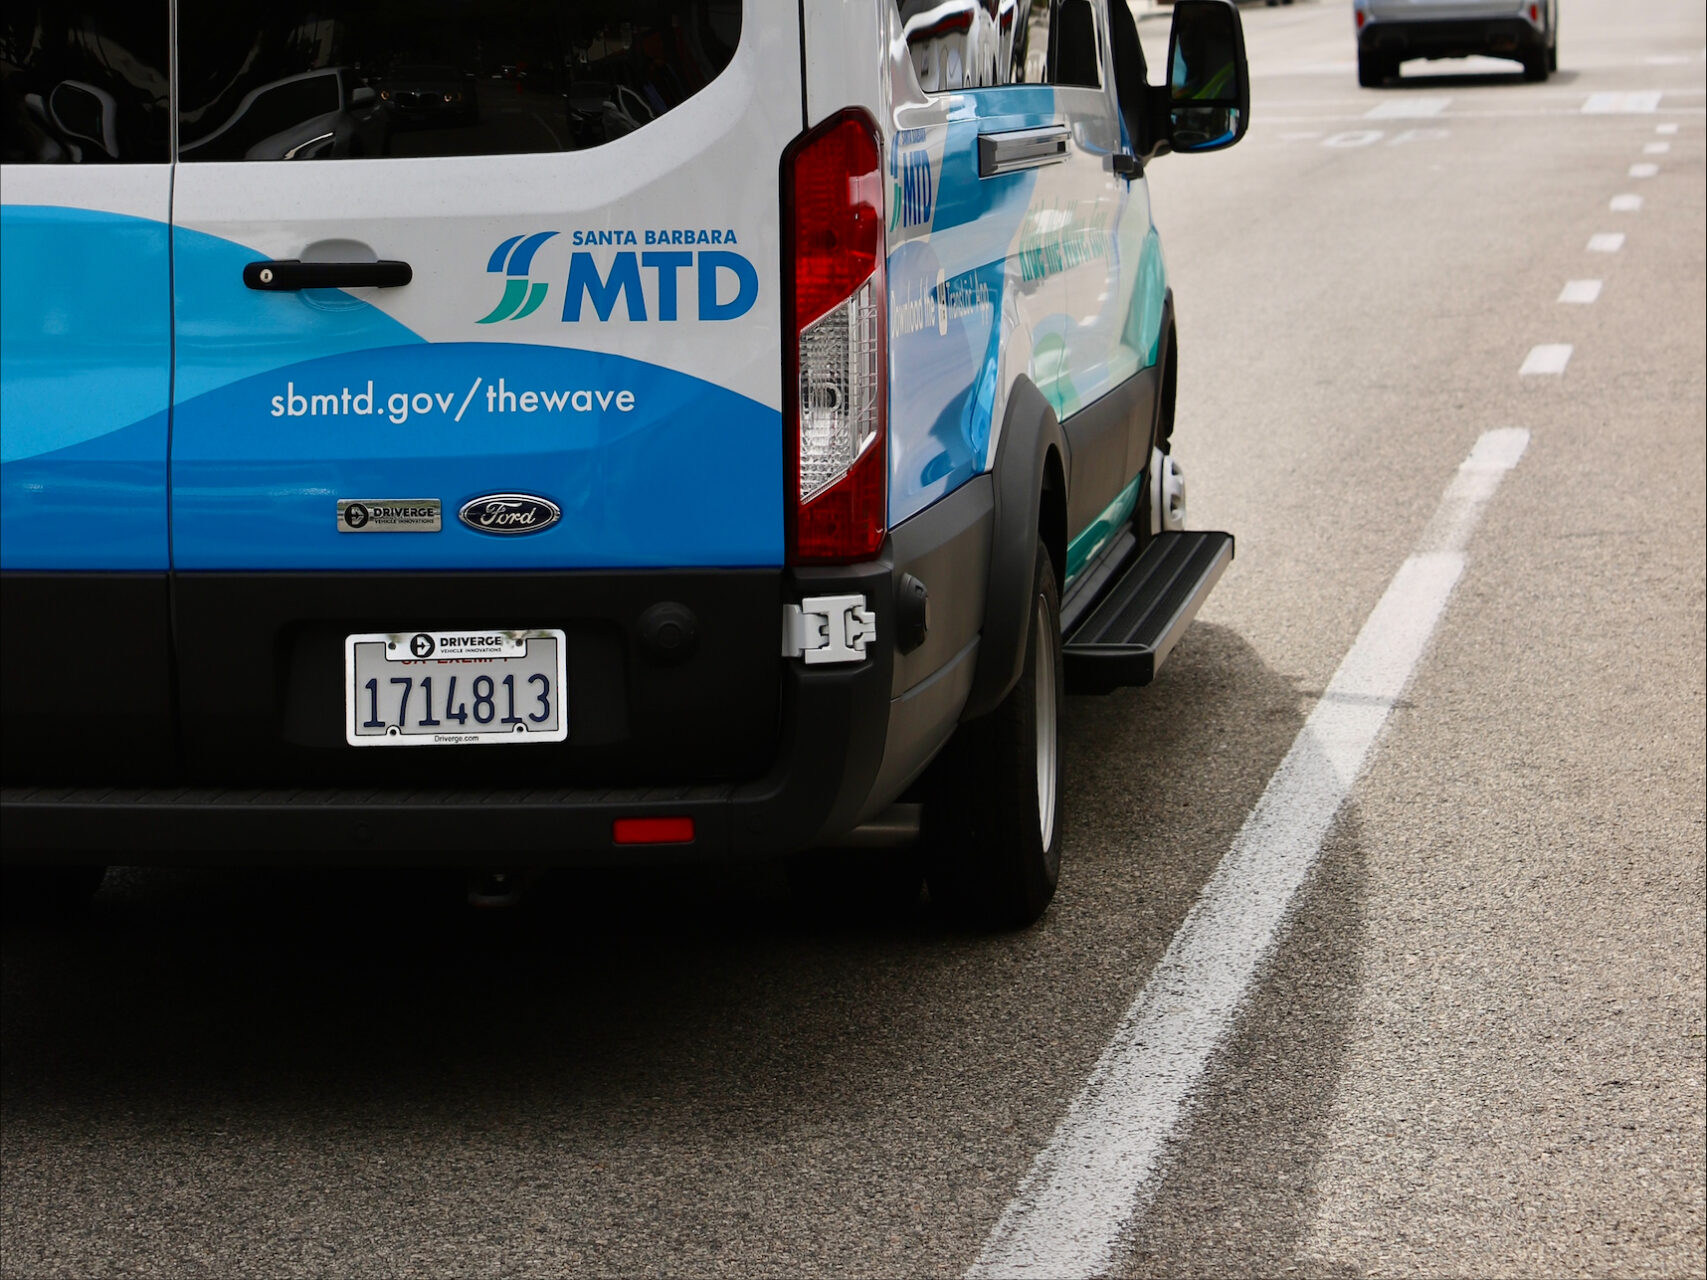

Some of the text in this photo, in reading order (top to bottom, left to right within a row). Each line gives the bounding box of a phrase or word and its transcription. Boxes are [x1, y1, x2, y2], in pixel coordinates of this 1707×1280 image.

[903, 150, 931, 227] MTD
[572, 230, 737, 245] SANTA BARBARA
[561, 251, 758, 322] MTD
[891, 278, 923, 337] Download
[923, 278, 935, 326] the
[270, 377, 635, 424] sbmtd.gov/thewave
[374, 508, 434, 517] DRIVERGE
[480, 501, 537, 525] Ford
[440, 637, 502, 646] DRIVERGE
[363, 673, 550, 728] 1714813
[434, 735, 479, 743] Driverge.com
